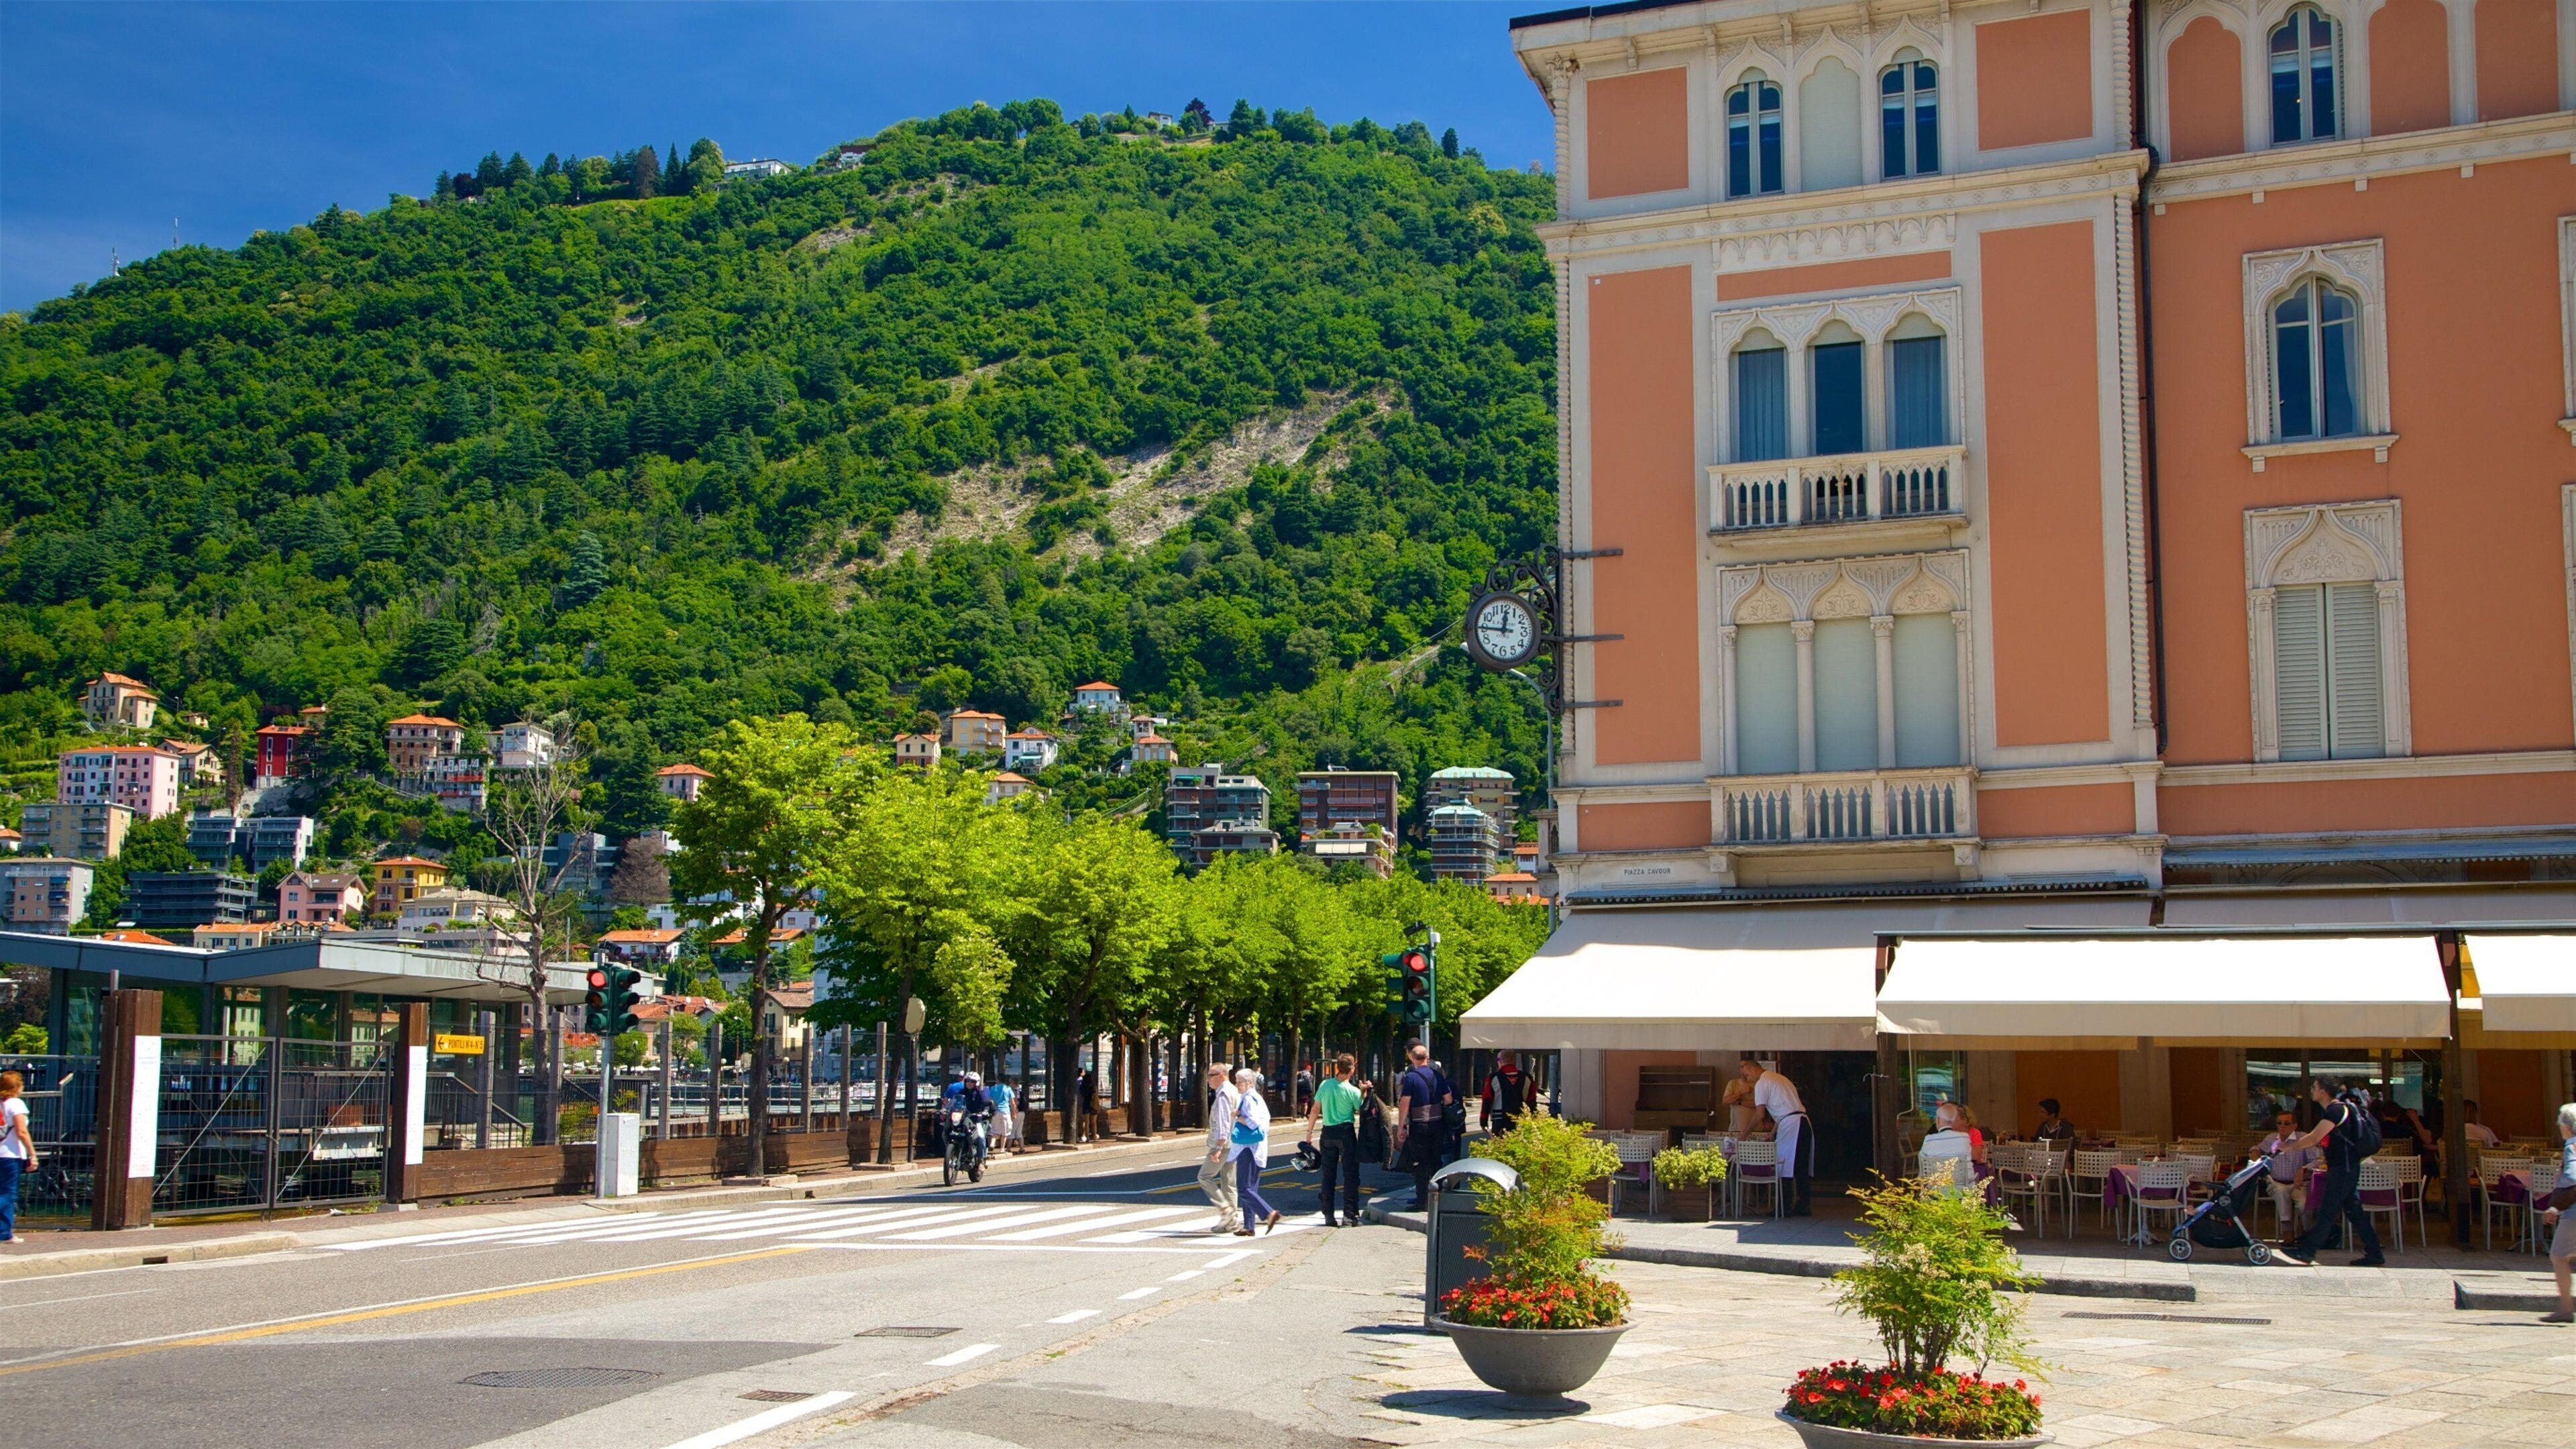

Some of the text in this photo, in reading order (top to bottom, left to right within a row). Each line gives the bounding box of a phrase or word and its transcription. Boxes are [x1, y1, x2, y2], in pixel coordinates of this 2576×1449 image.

[1492, 605, 1498, 616] 11
[1501, 604, 1511, 614] 12
[1484, 612, 1493, 622] 10
[1518, 614, 1525, 625] 2
[1481, 623, 1487, 633] 9
[1520, 627, 1528, 637] 3
[1483, 633, 1490, 644] 8
[1517, 639, 1524, 648] 4
[1492, 643, 1497, 653] 7
[1499, 646, 1507, 656] 6
[1510, 645, 1516, 655] 5
